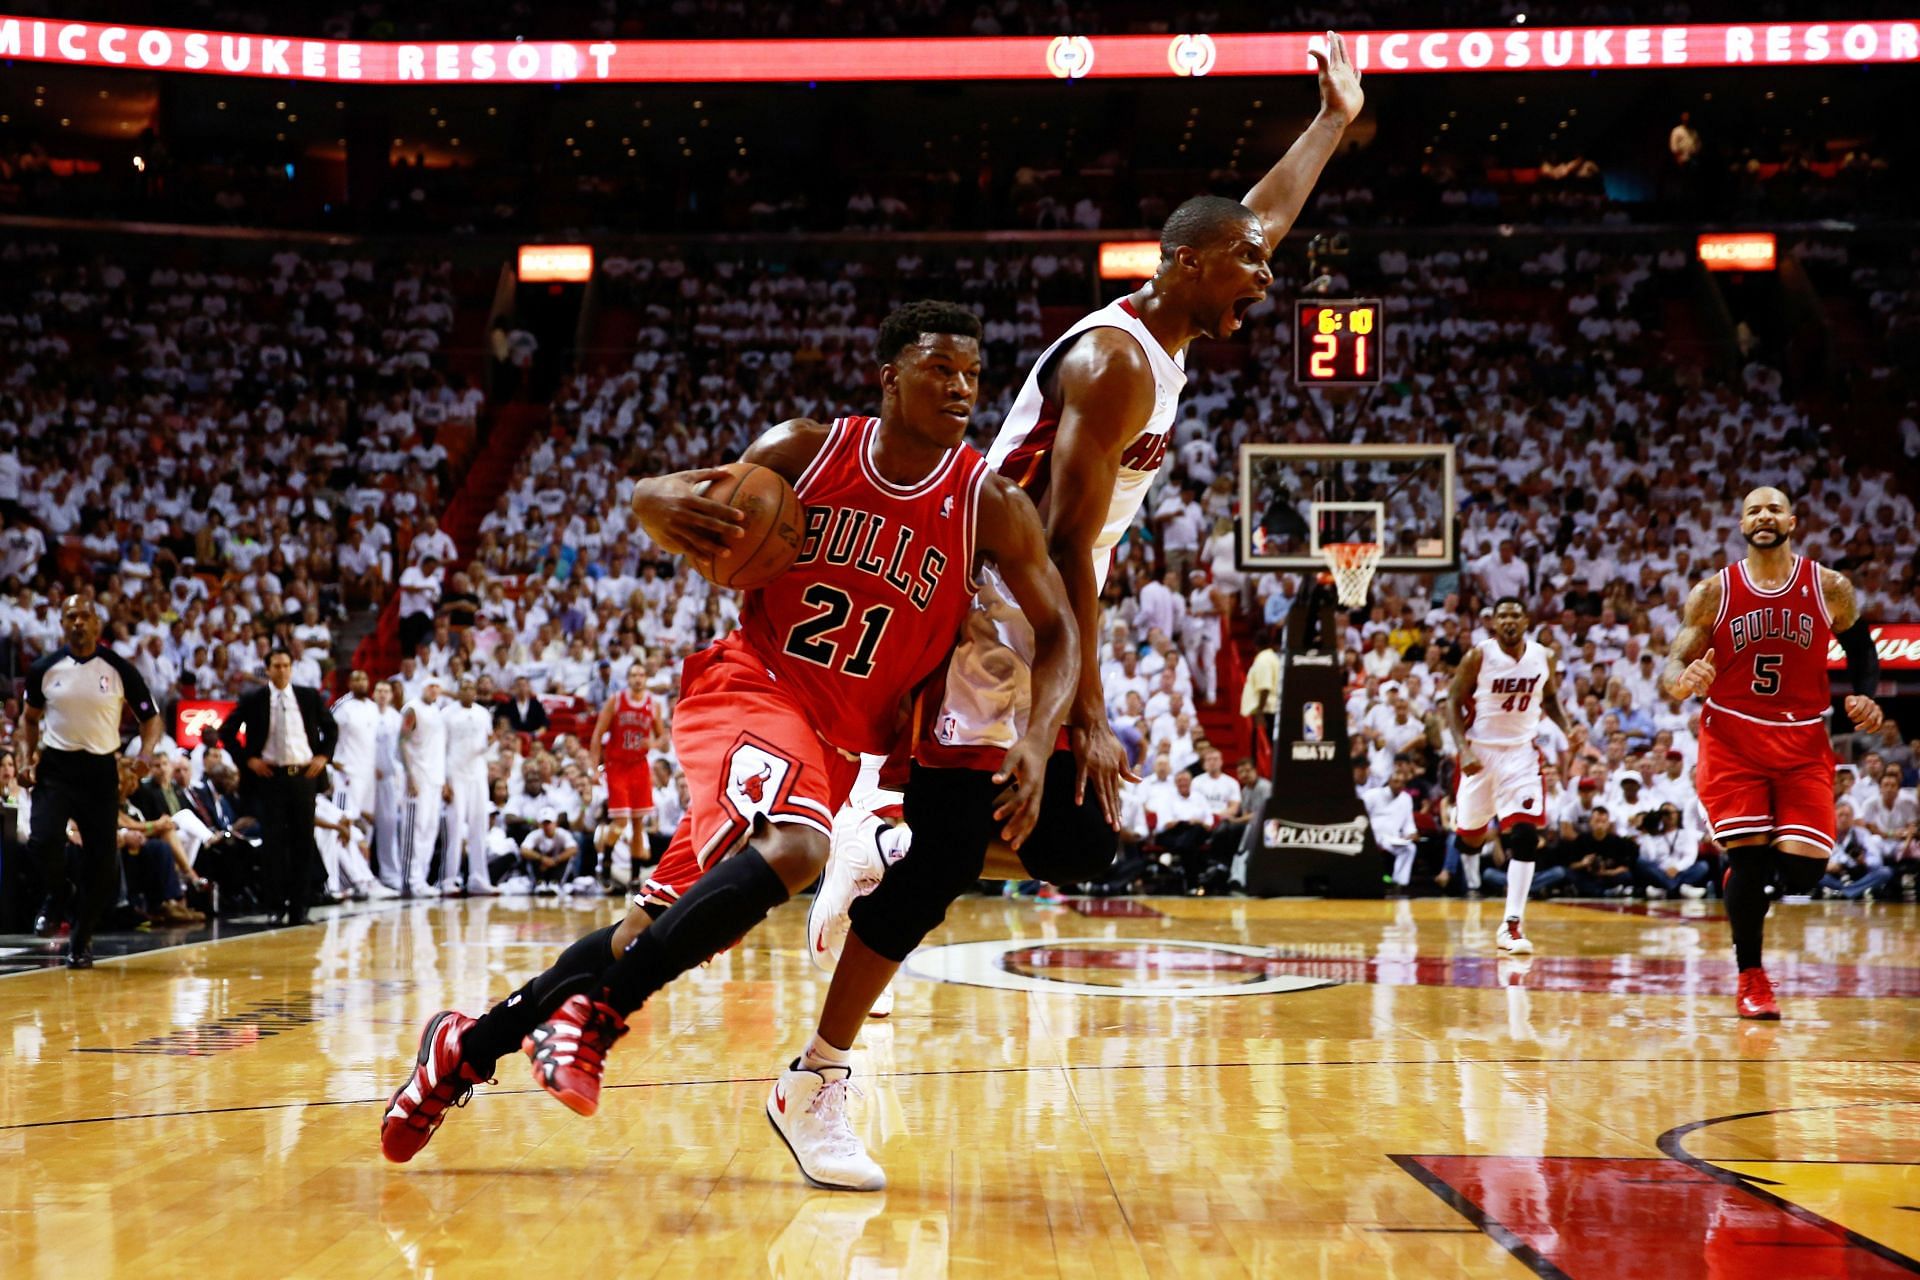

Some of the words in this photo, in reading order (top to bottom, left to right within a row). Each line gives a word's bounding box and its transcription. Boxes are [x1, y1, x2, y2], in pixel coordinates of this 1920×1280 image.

[398, 43, 616, 79] RESORT
[1726, 23, 1919, 62] RESOR
[1318, 308, 1373, 334] 6:10
[1311, 334, 1365, 377] 21
[794, 505, 947, 612] BULLS
[783, 582, 894, 679] 21
[1730, 608, 1813, 652] BULLS
[1491, 673, 1541, 693] HEAT
[1751, 653, 1783, 696] 5
[1501, 694, 1531, 712] 40
[1277, 826, 1365, 844] PLAYOFFS
